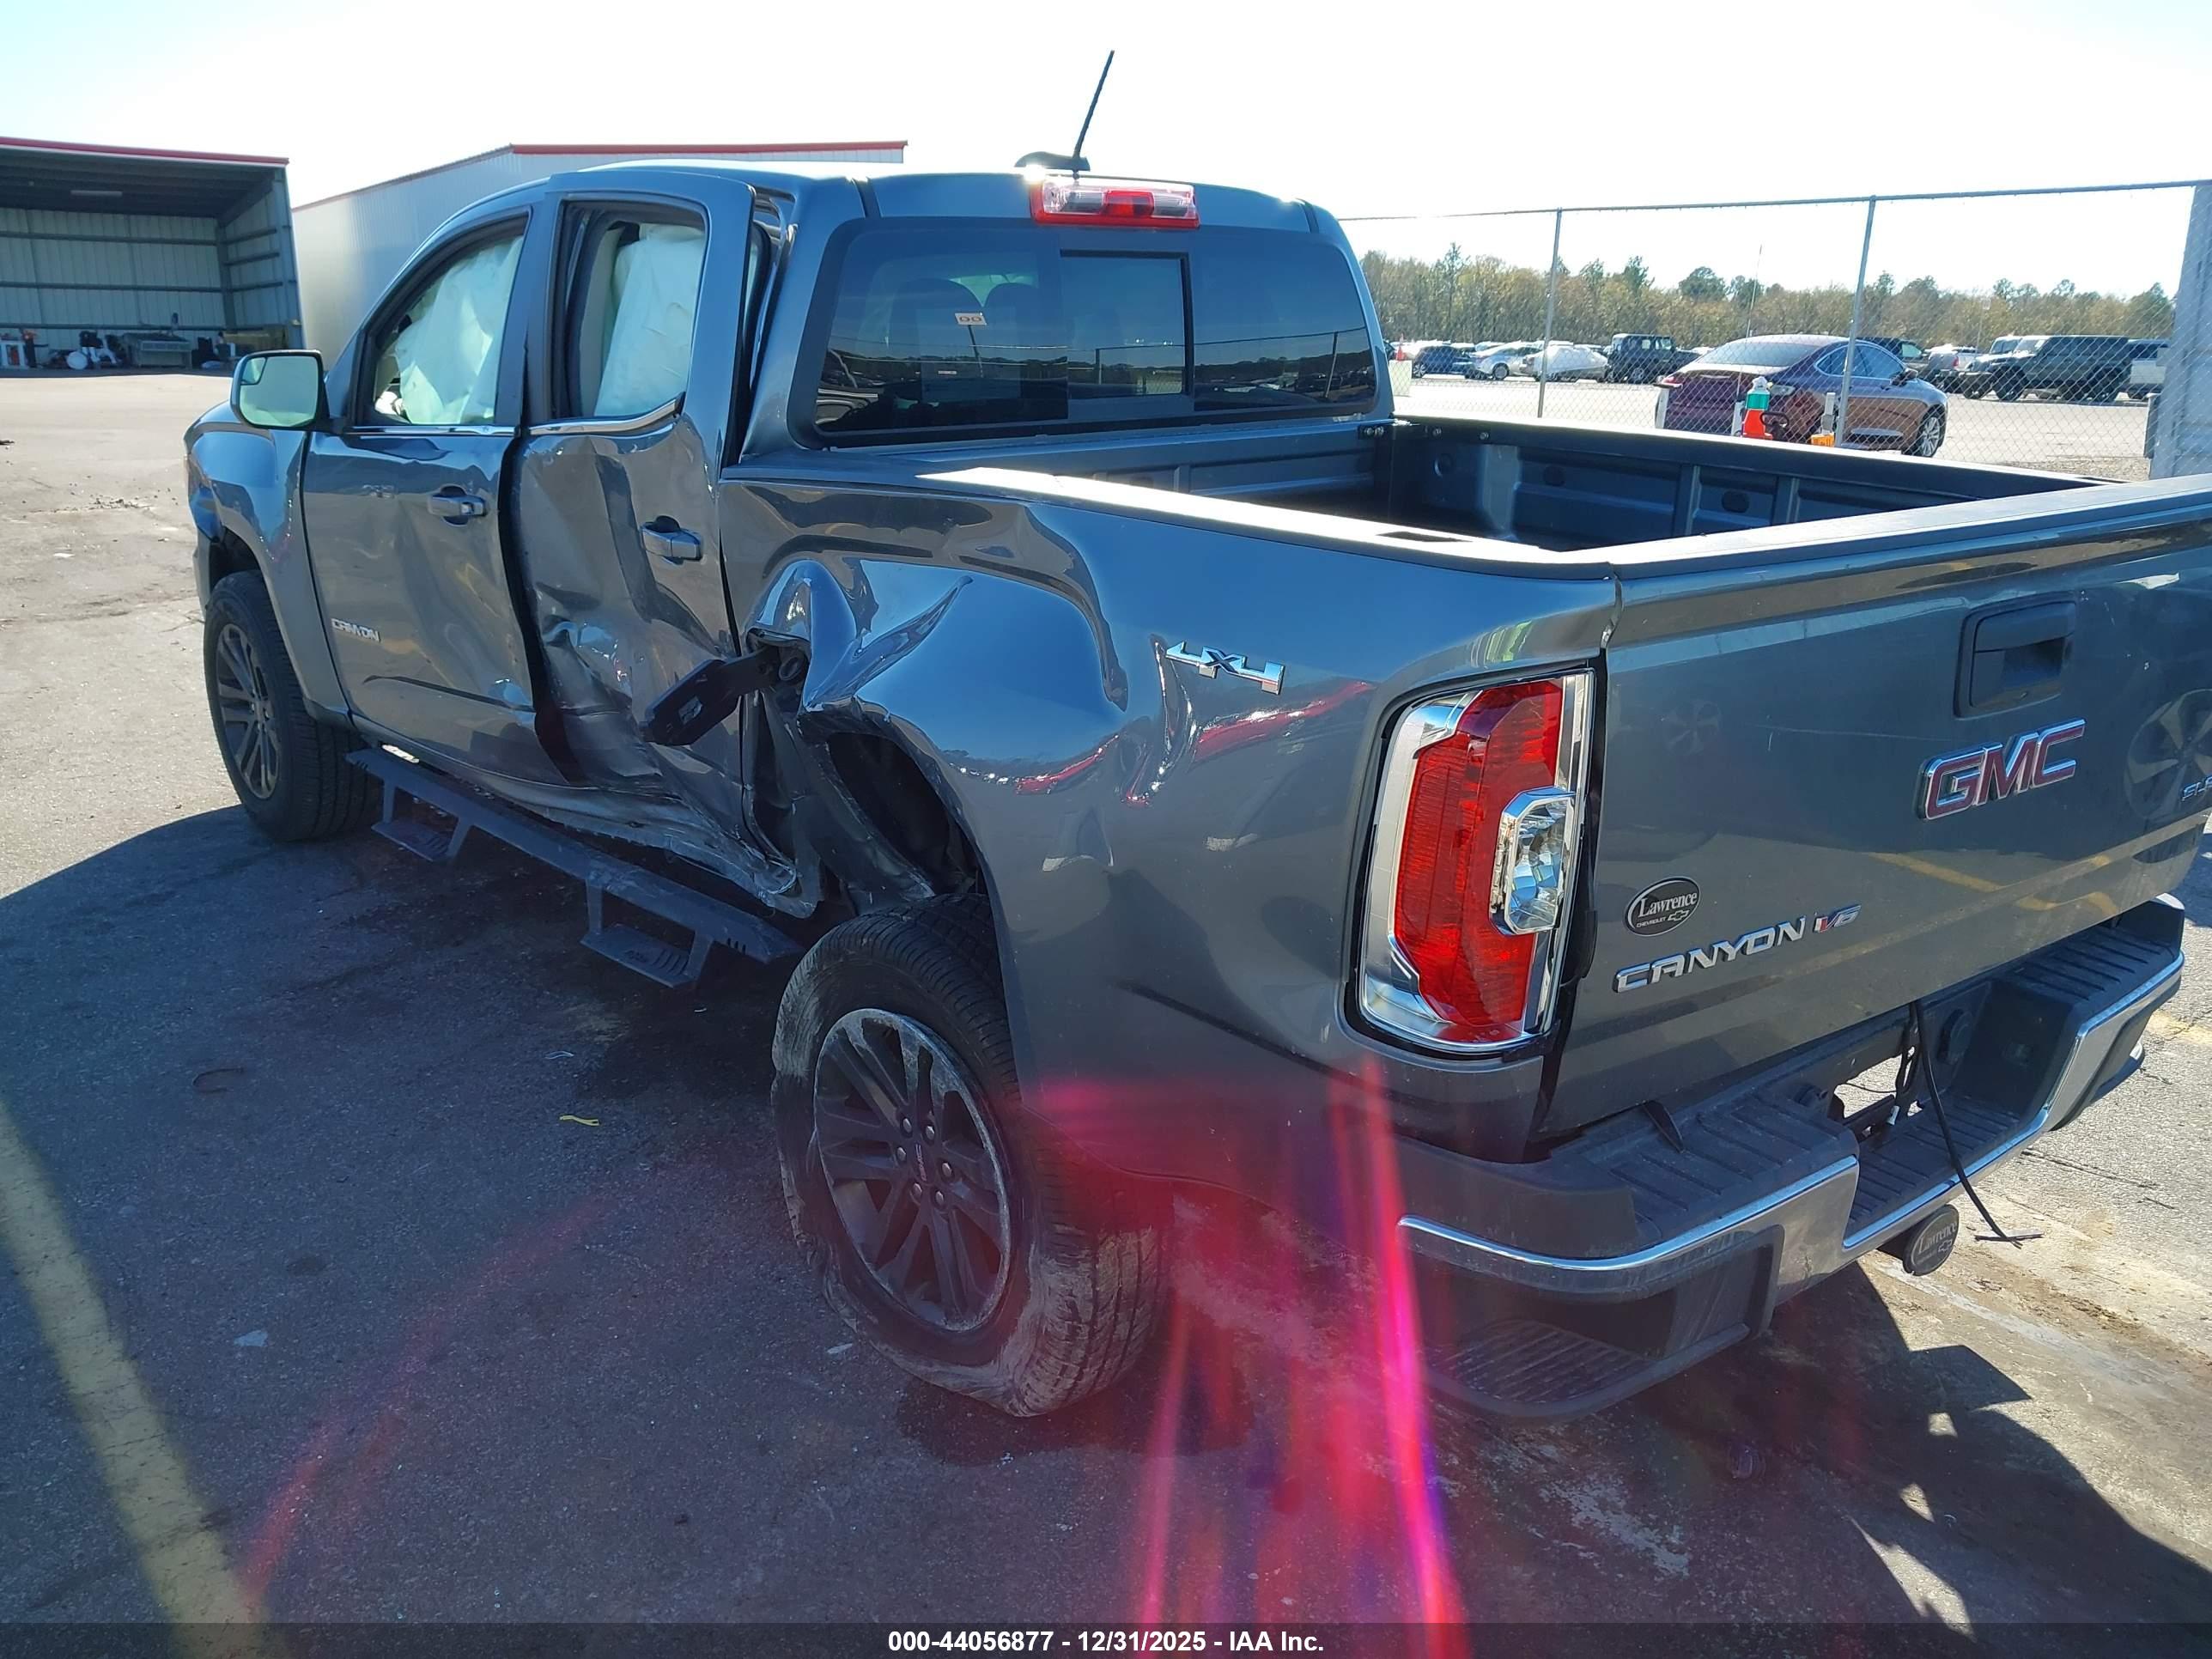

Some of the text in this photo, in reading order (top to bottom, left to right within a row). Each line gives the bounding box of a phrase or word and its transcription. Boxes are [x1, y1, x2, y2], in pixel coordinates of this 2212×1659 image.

[1922, 718, 2086, 820] GMC
[1636, 916, 1666, 928] CHEVROLET
[1638, 892, 1698, 918] Lawrence
[1614, 904, 1862, 993] CANYON V6
